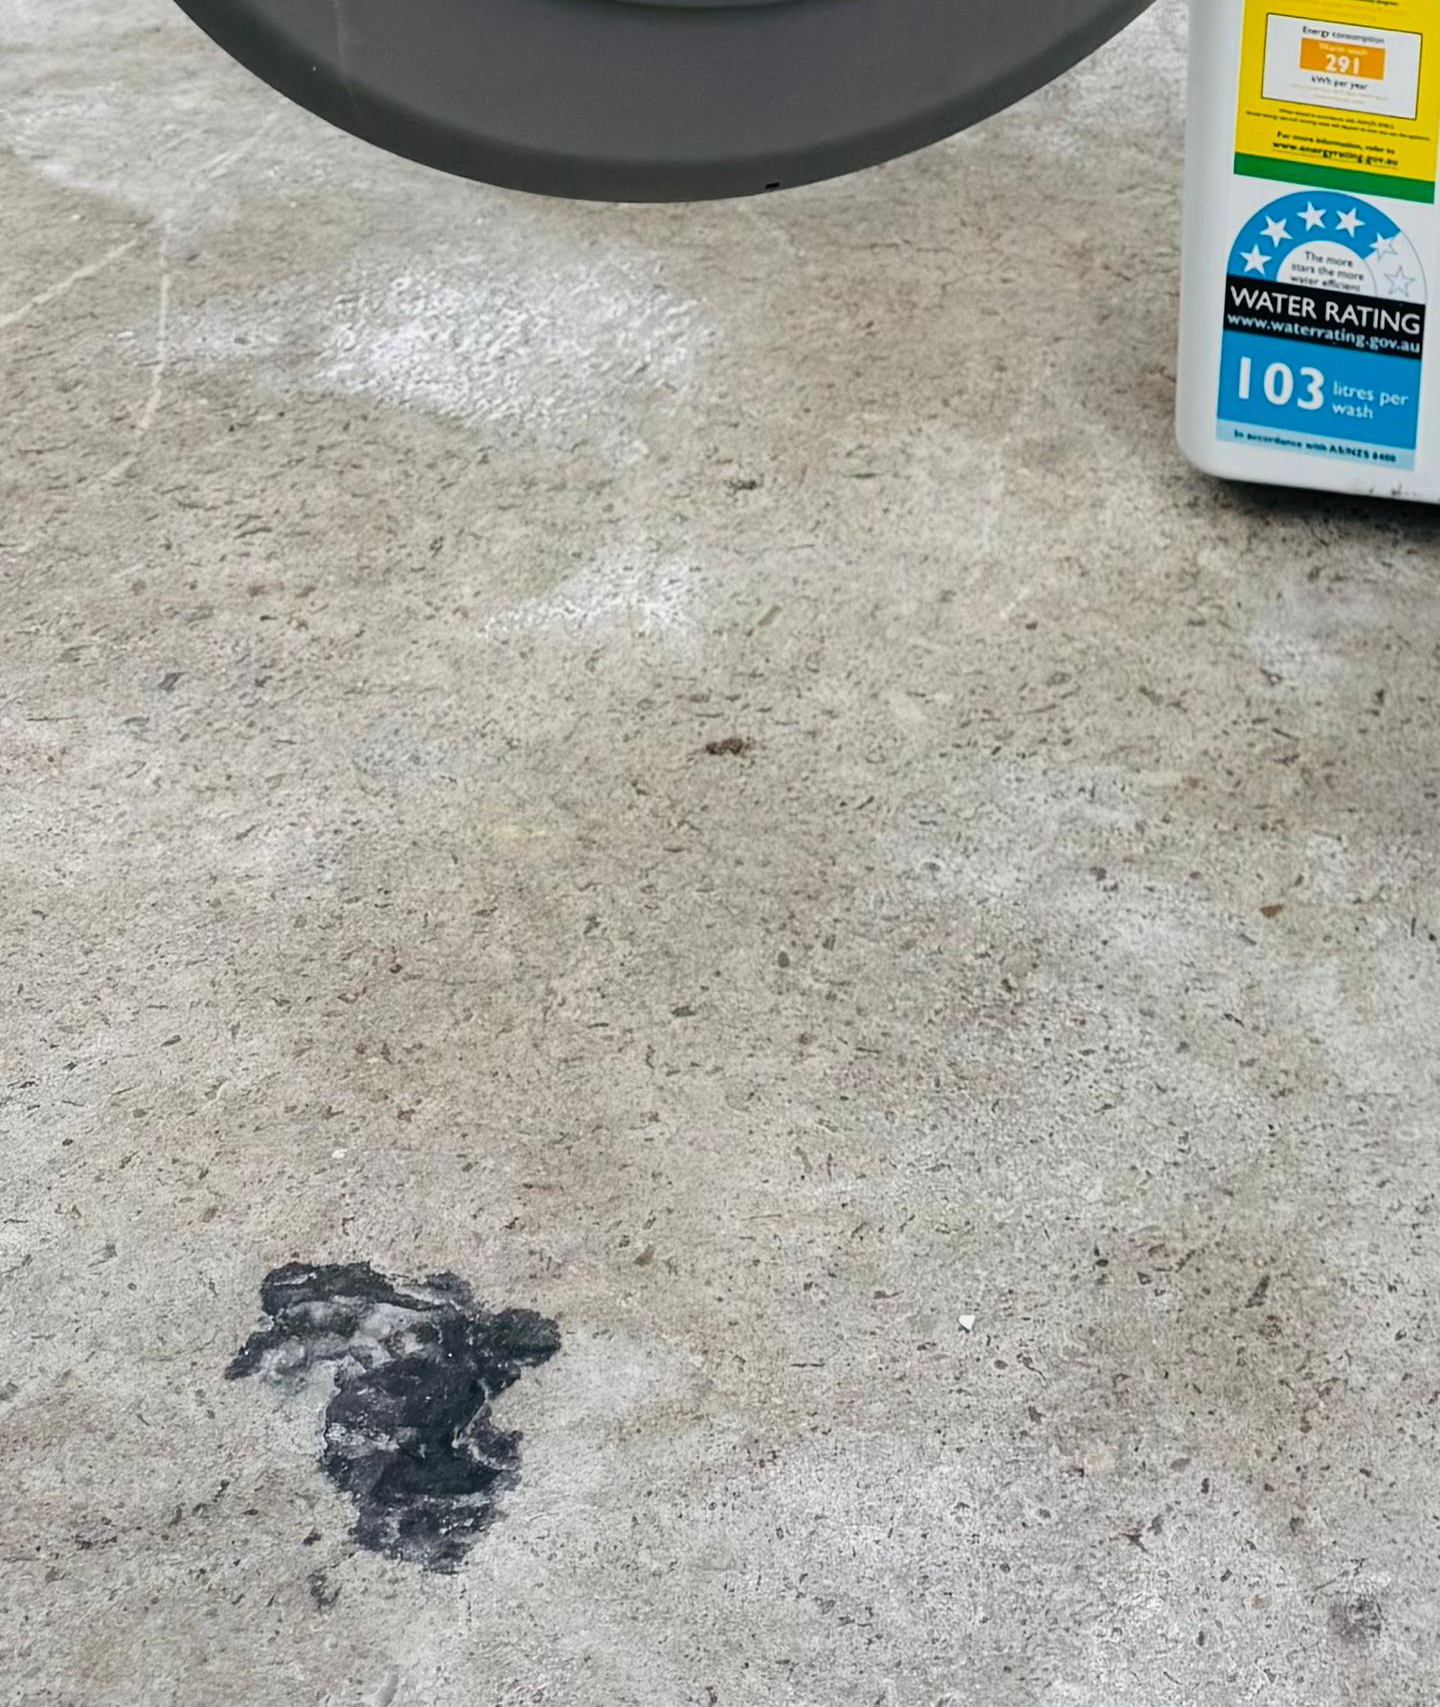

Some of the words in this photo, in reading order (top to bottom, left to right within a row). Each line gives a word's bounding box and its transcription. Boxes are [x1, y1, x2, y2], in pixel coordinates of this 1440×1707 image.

[1302, 25, 1329, 39] Energy
[1325, 53, 1361, 75] 291
[1334, 79, 1348, 89] per
[1305, 250, 1325, 264] The
[1326, 256, 1353, 268] more
[1291, 263, 1315, 274] stars
[1317, 266, 1334, 277] the
[1337, 270, 1364, 281] more
[1290, 275, 1319, 287] water
[1322, 278, 1361, 293] efficient
[1230, 285, 1318, 320] WATER
[1324, 301, 1420, 335] RATING
[1227, 312, 1421, 354] www.waterrating.gov.au
[1238, 356, 1325, 411] 103
[1332, 380, 1374, 402] litres
[1379, 390, 1410, 407] per
[1332, 402, 1374, 420] wash
